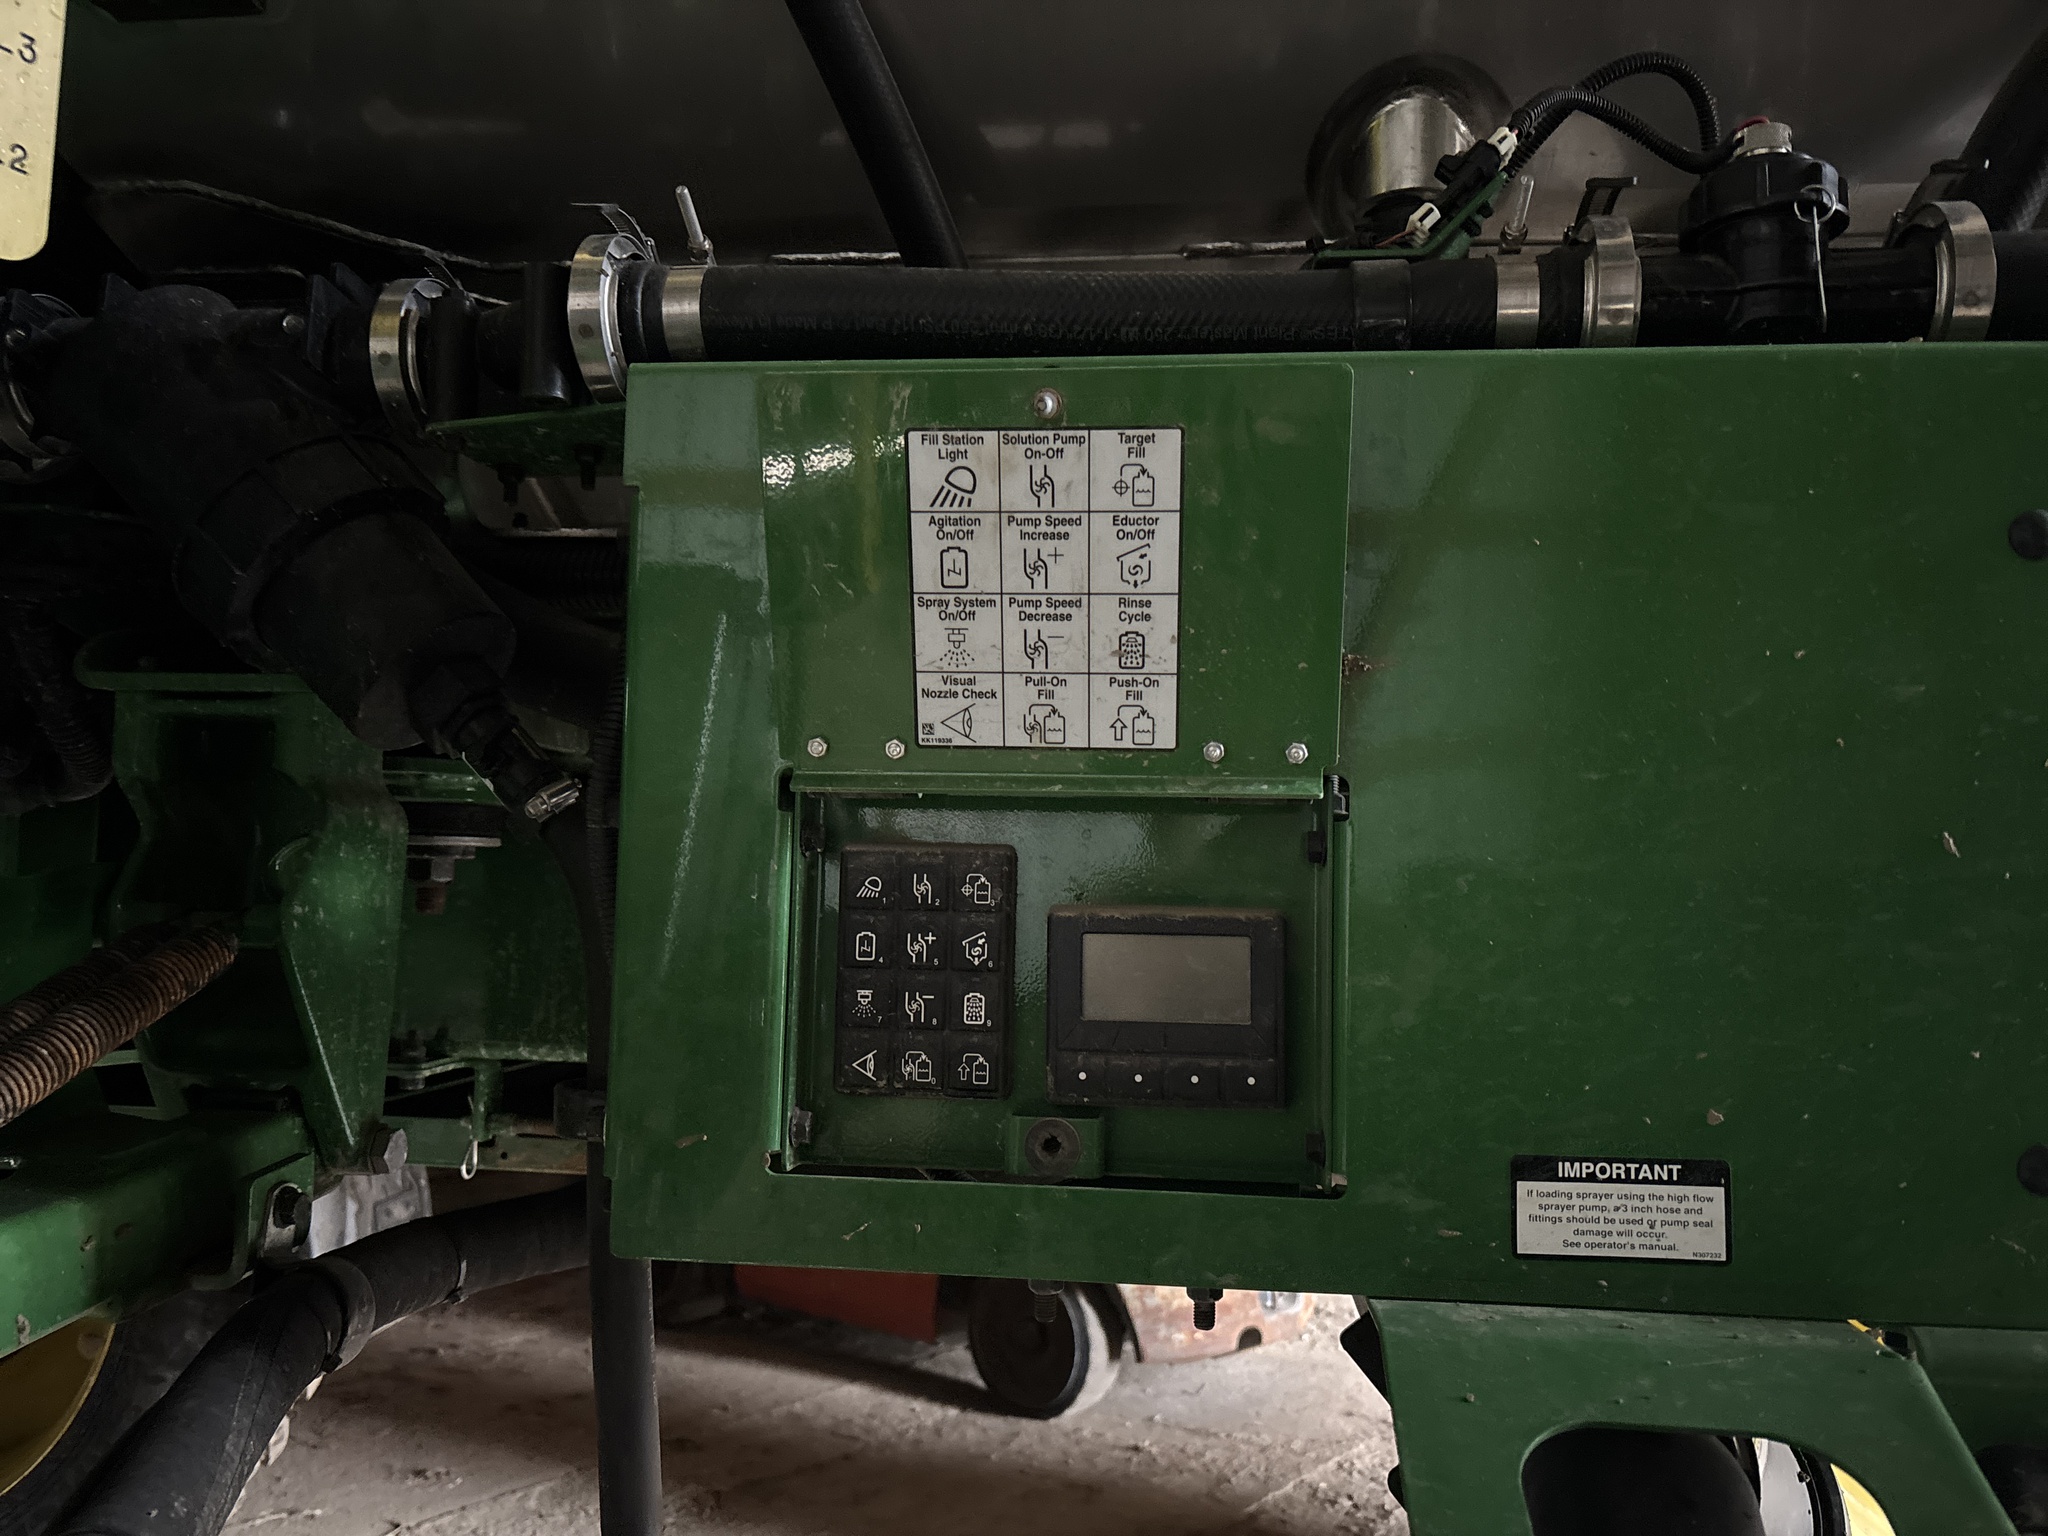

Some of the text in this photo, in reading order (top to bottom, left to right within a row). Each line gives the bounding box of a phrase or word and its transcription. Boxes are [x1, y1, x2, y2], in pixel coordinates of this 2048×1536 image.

[921, 434, 984, 445] Fill Station
[1003, 433, 1085, 446] Solution Pump
[1118, 433, 1155, 444] Target
[938, 449, 968, 462] Light
[1025, 448, 1064, 459] On-Off
[1128, 448, 1145, 458] Fill
[929, 516, 981, 528] Agitation
[1008, 516, 1082, 528] Pump Speed
[1113, 515, 1159, 526] Eductor
[936, 530, 974, 541] On/Off
[1020, 530, 1070, 541] Increase
[1117, 529, 1155, 540] On/Off
[917, 598, 996, 610] Spray System
[1009, 598, 1082, 610] Pump Speed
[1119, 597, 1151, 608] Rinse
[939, 611, 976, 621] On/Off
[1019, 611, 1072, 622] Decrease
[1119, 611, 1151, 624] Cycle
[942, 675, 976, 686] Visual
[1025, 676, 1066, 686] Pull-On
[1110, 677, 1159, 687] Push-On
[922, 688, 997, 699] Nozzle Check
[1038, 690, 1054, 699] Fill
[1126, 690, 1142, 700] Fill
[932, 1018, 938, 1026] 8
[1559, 1162, 1681, 1180] IMPORTANT
[1536, 1190, 1572, 1200] loading
[1576, 1192, 1614, 1201] sprayer
[1617, 1193, 1645, 1202] using
[1649, 1193, 1664, 1201] the
[1668, 1193, 1689, 1203] high
[1693, 1194, 1714, 1203] flow
[1538, 1203, 1576, 1212] sprayer
[1579, 1205, 1610, 1213] pump,
[1622, 1204, 1628, 1212] 3
[1631, 1205, 1652, 1213] inch
[1656, 1206, 1681, 1214] hose
[1684, 1207, 1703, 1215] and
[1529, 1215, 1713, 1229] fittings should be used or pump seal
[1573, 1228, 1667, 1239] damage will occur.
[1563, 1240, 1679, 1251] See operator's manual.
